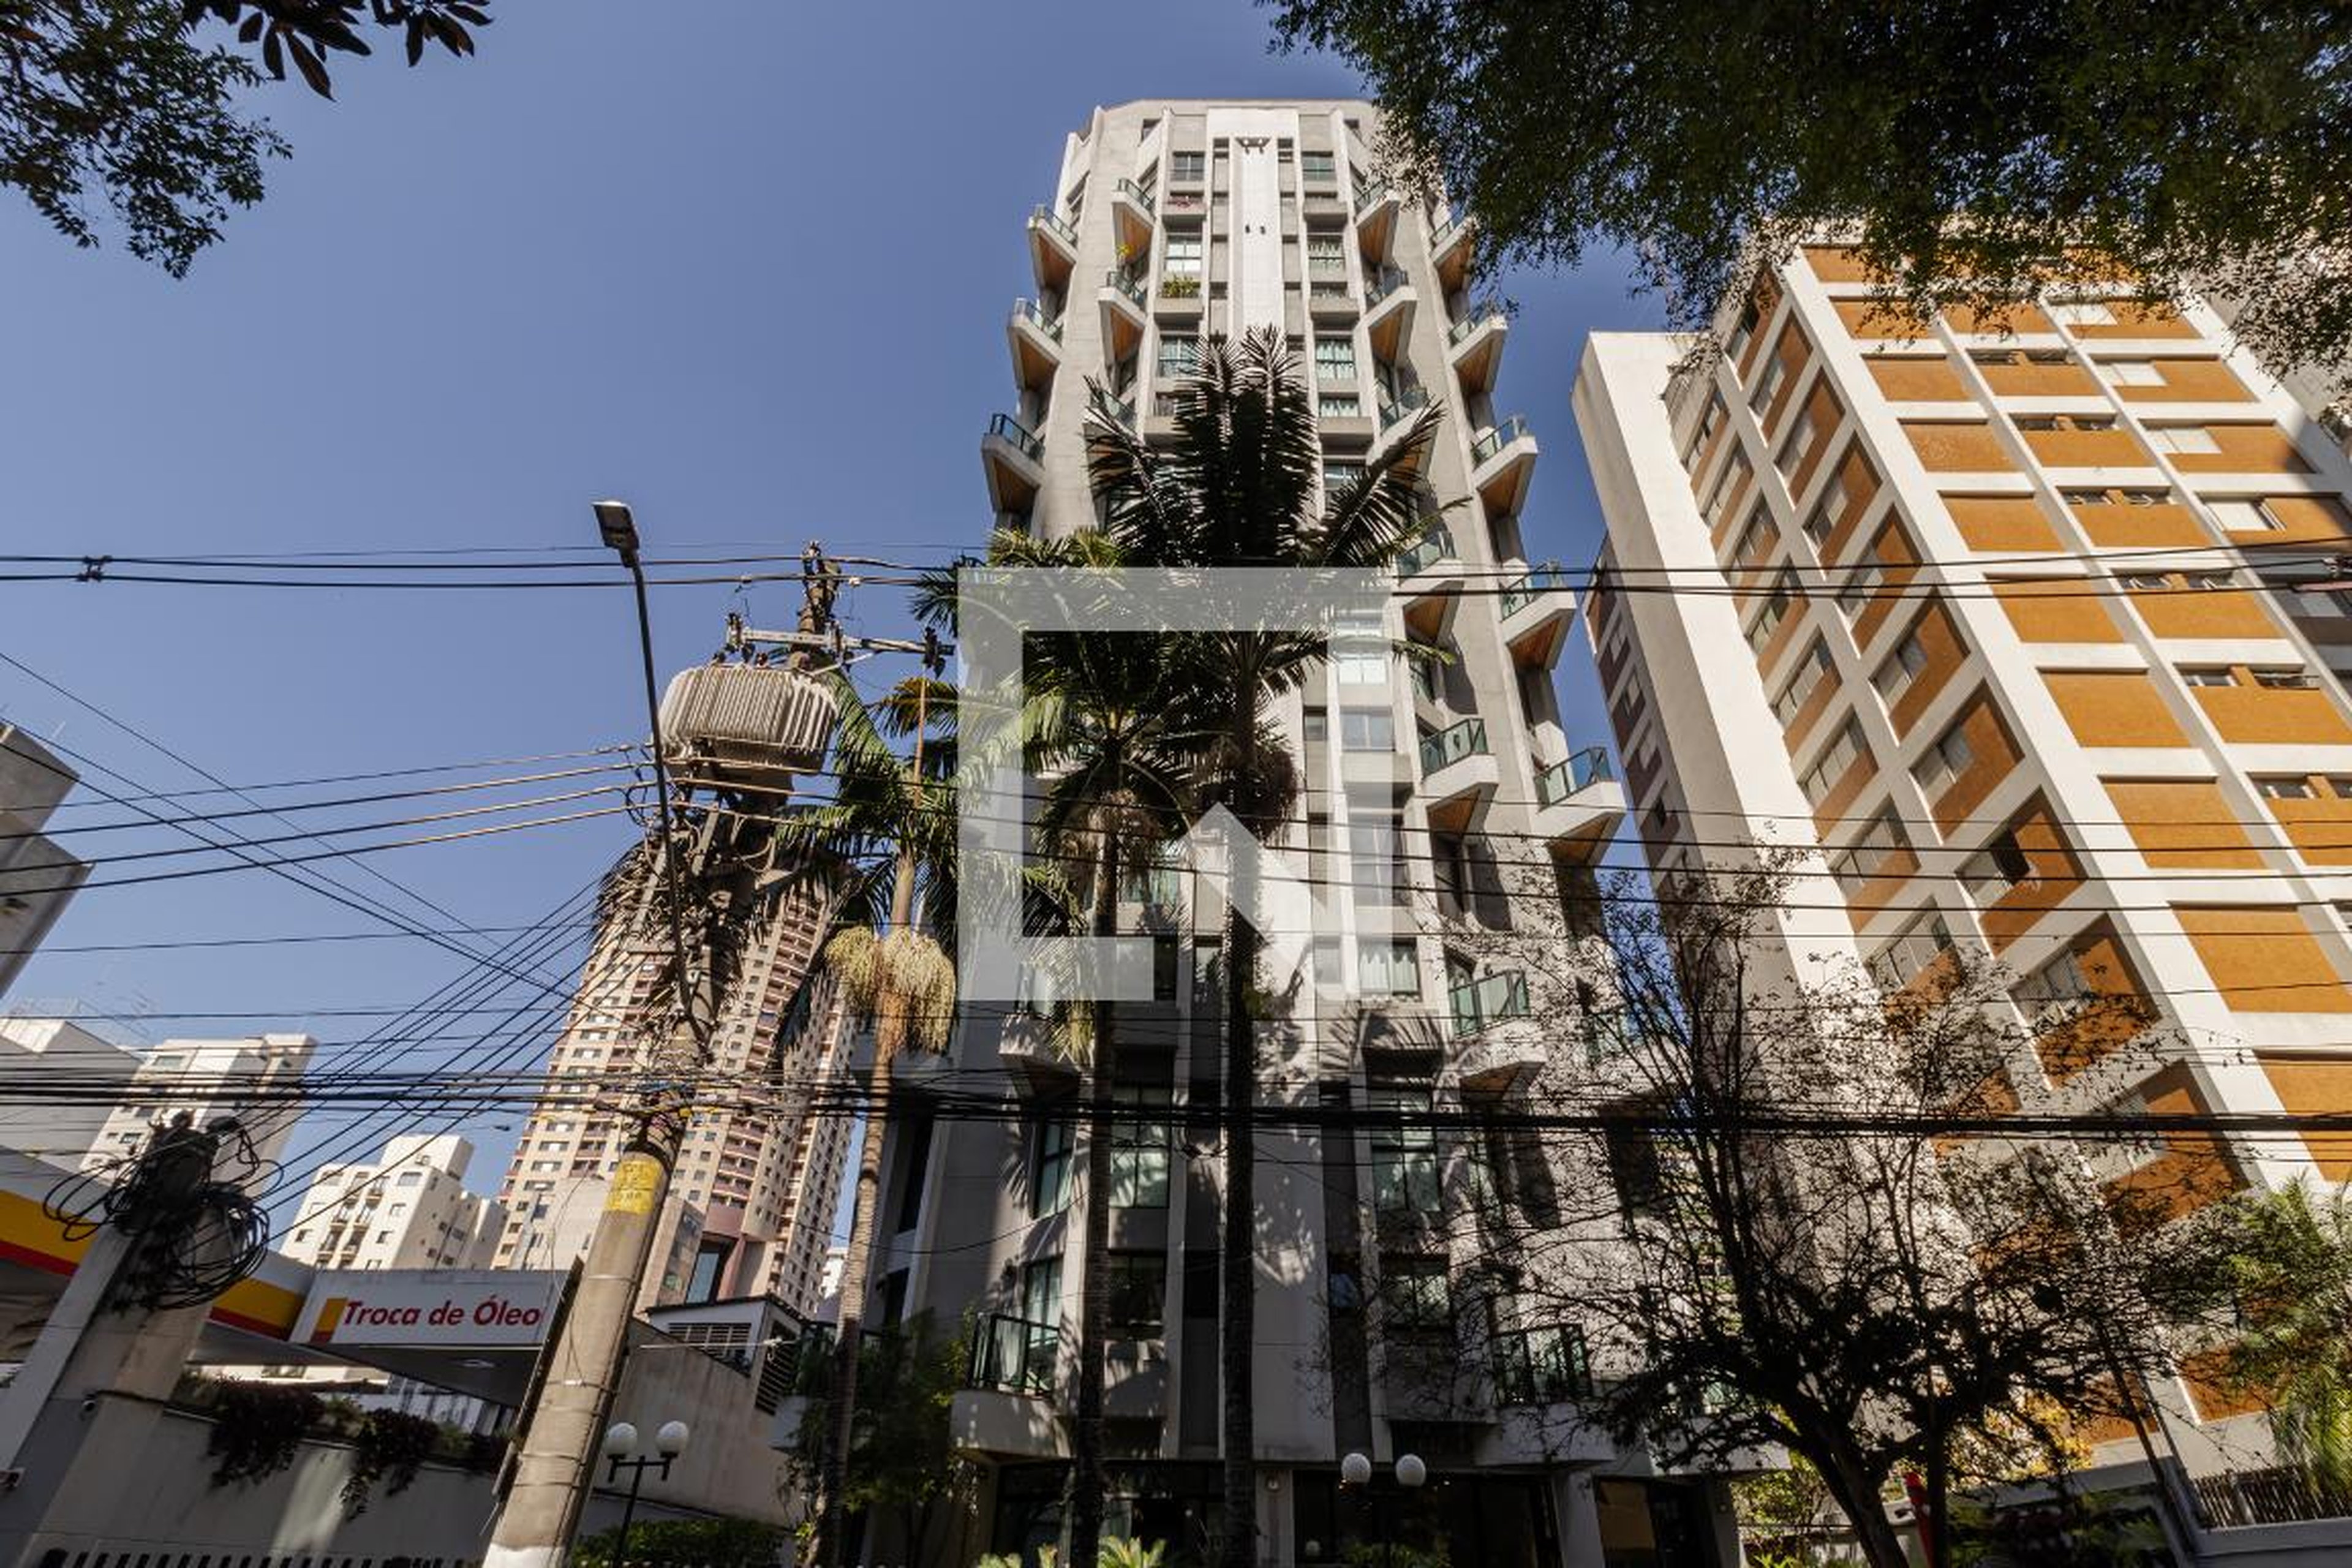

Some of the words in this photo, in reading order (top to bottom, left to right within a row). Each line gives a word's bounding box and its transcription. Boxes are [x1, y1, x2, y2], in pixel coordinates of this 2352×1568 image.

[344, 1300, 421, 1325] Troca
[428, 1300, 464, 1325] de
[473, 1294, 540, 1325] Óleo
